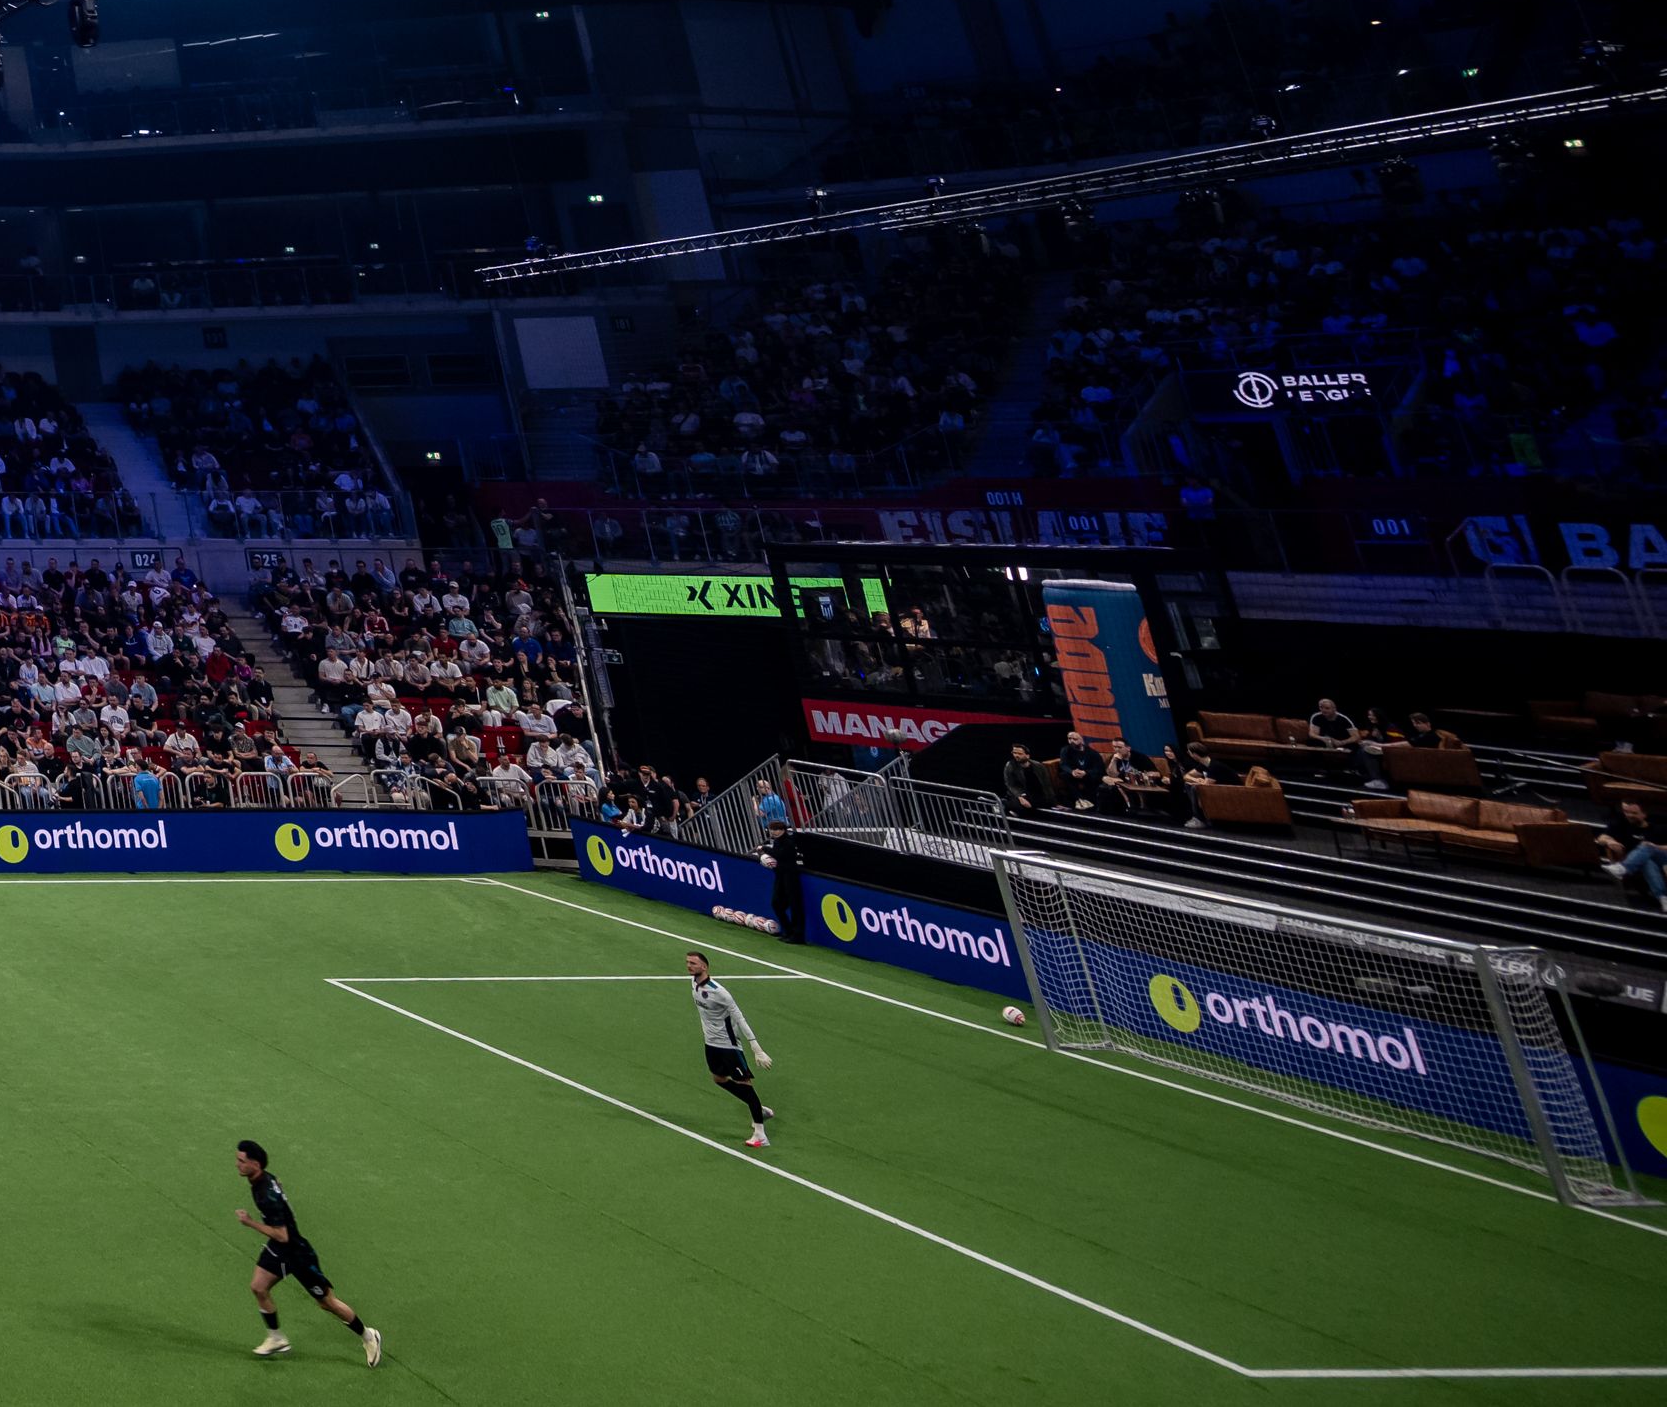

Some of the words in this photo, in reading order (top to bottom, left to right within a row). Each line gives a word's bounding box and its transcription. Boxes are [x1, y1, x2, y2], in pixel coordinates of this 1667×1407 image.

[1281, 373, 1368, 387] BALLER
[1068, 515, 1099, 531] 001
[1372, 519, 1411, 535] 001
[34, 820, 168, 850] orthomol
[315, 820, 460, 851] orthomol
[615, 843, 724, 894] orthomol
[860, 904, 1011, 968] orthomol
[1204, 991, 1428, 1076] orthomol
